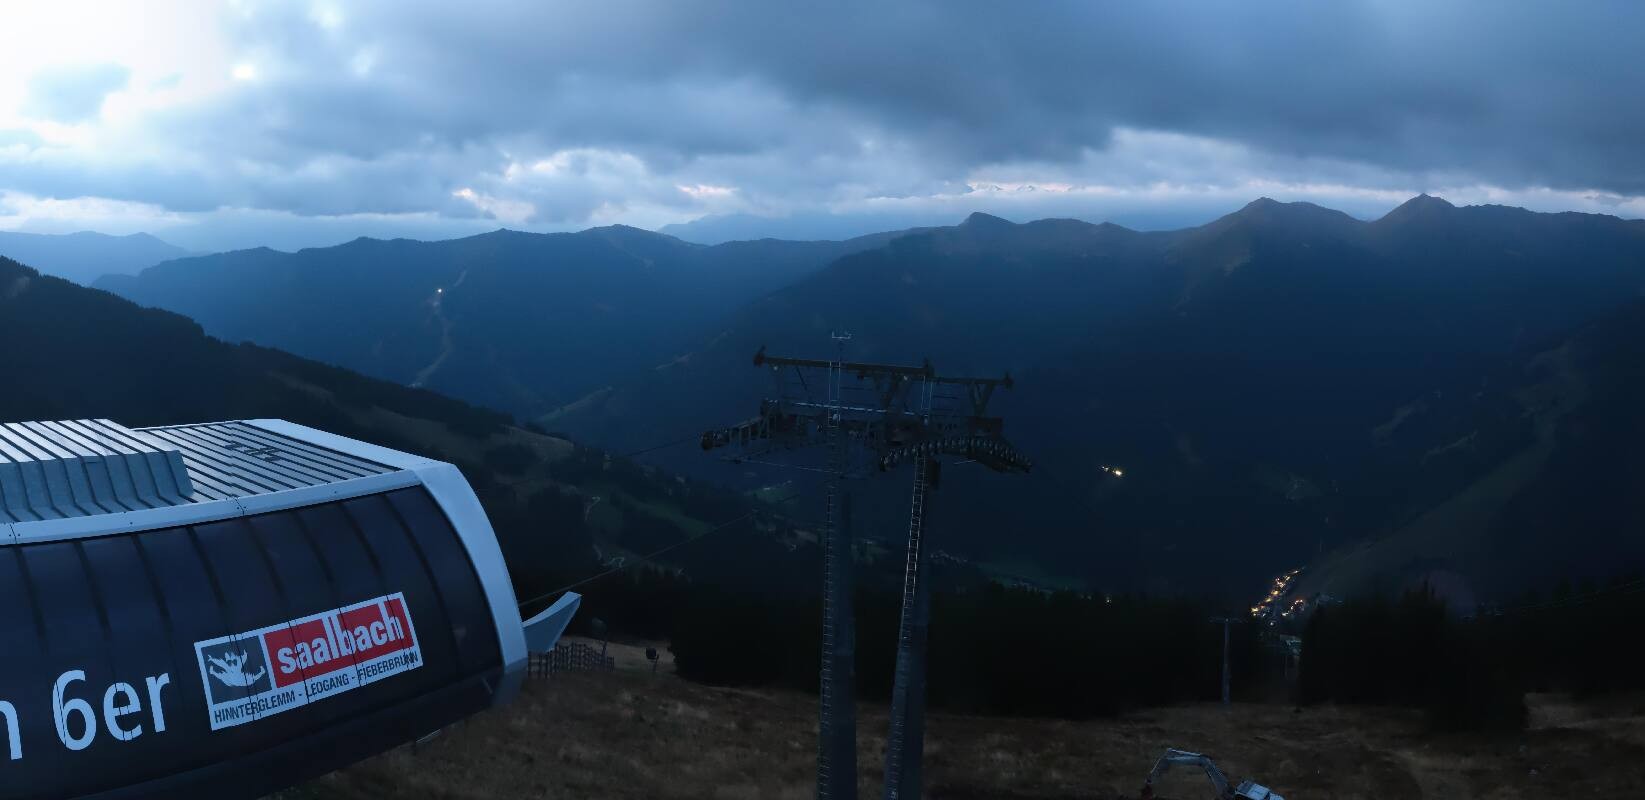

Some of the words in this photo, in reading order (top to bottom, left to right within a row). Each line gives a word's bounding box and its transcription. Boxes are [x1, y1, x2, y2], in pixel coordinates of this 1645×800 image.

[277, 602, 405, 675] saalbach
[53, 670, 170, 751] 6er
[306, 673, 350, 698] LEOGANG
